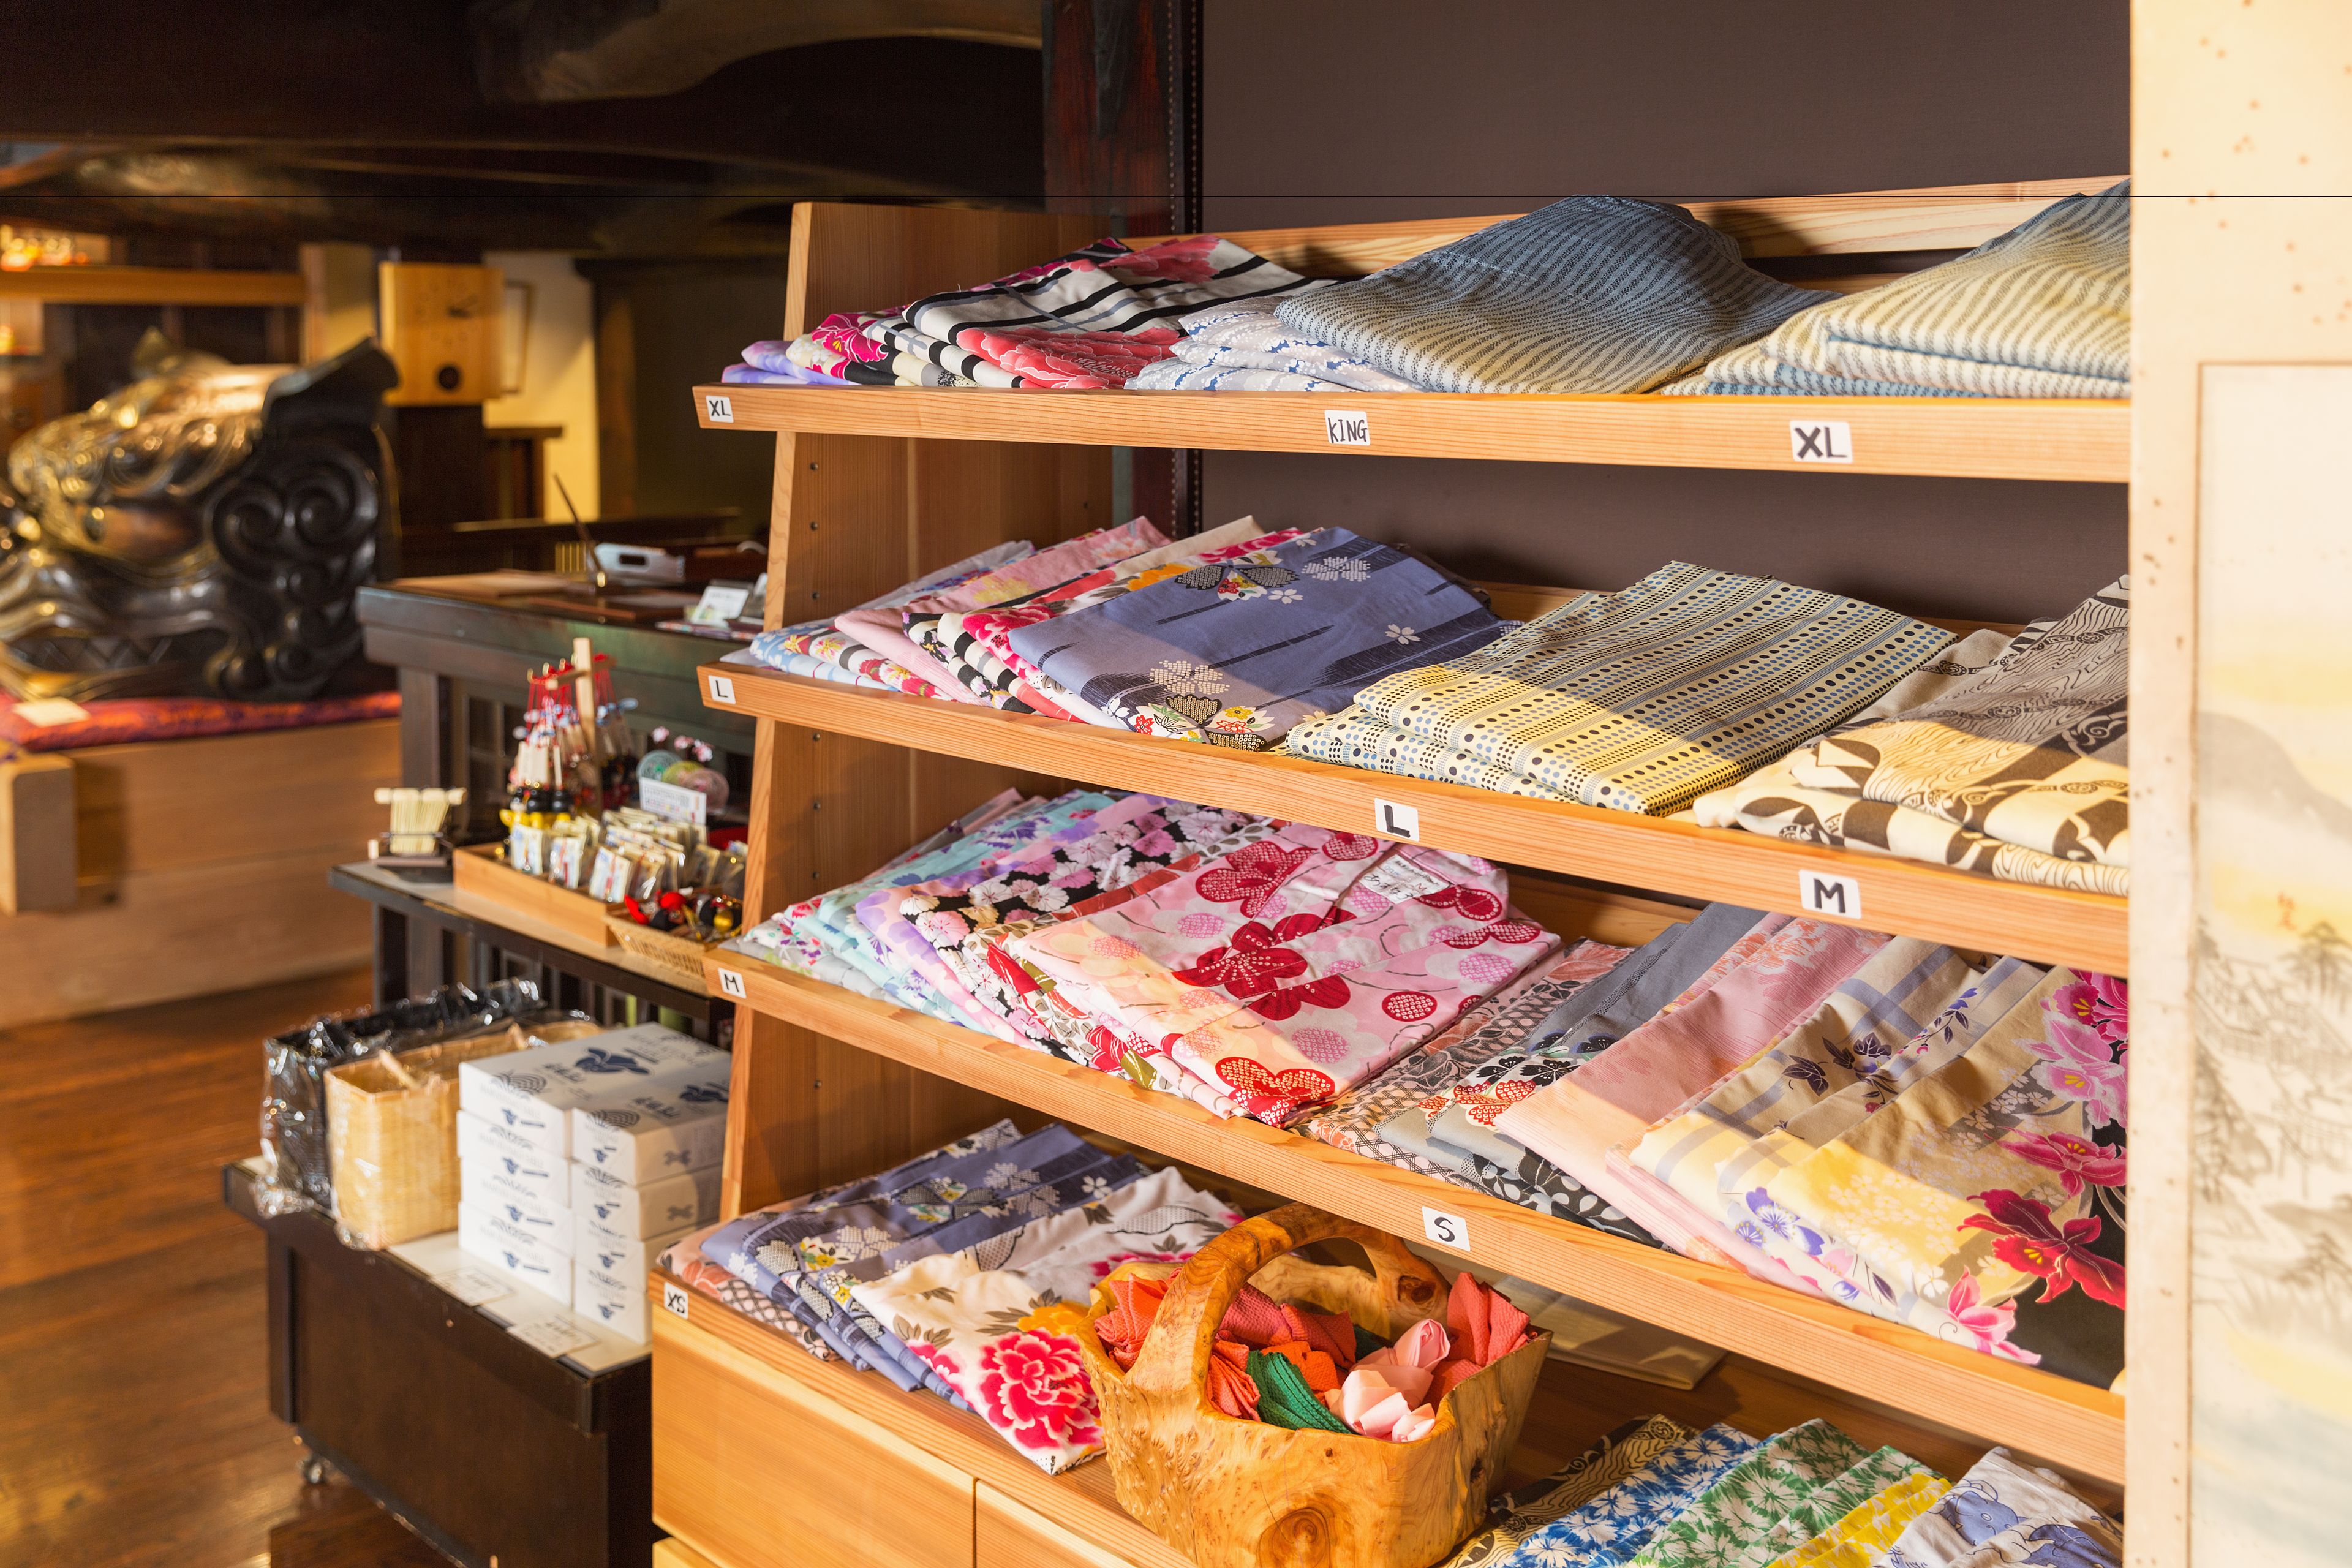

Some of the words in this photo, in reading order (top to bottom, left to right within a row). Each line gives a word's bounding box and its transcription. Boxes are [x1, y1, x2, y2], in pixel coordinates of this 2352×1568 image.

[709, 400, 731, 417] XL
[1795, 427, 1847, 458] XL
[715, 680, 728, 698] L
[1384, 805, 1411, 838] L
[1814, 878, 1845, 913] M
[724, 974, 739, 992] M
[1434, 1216, 1455, 1242] S
[668, 1292, 685, 1314] XS
